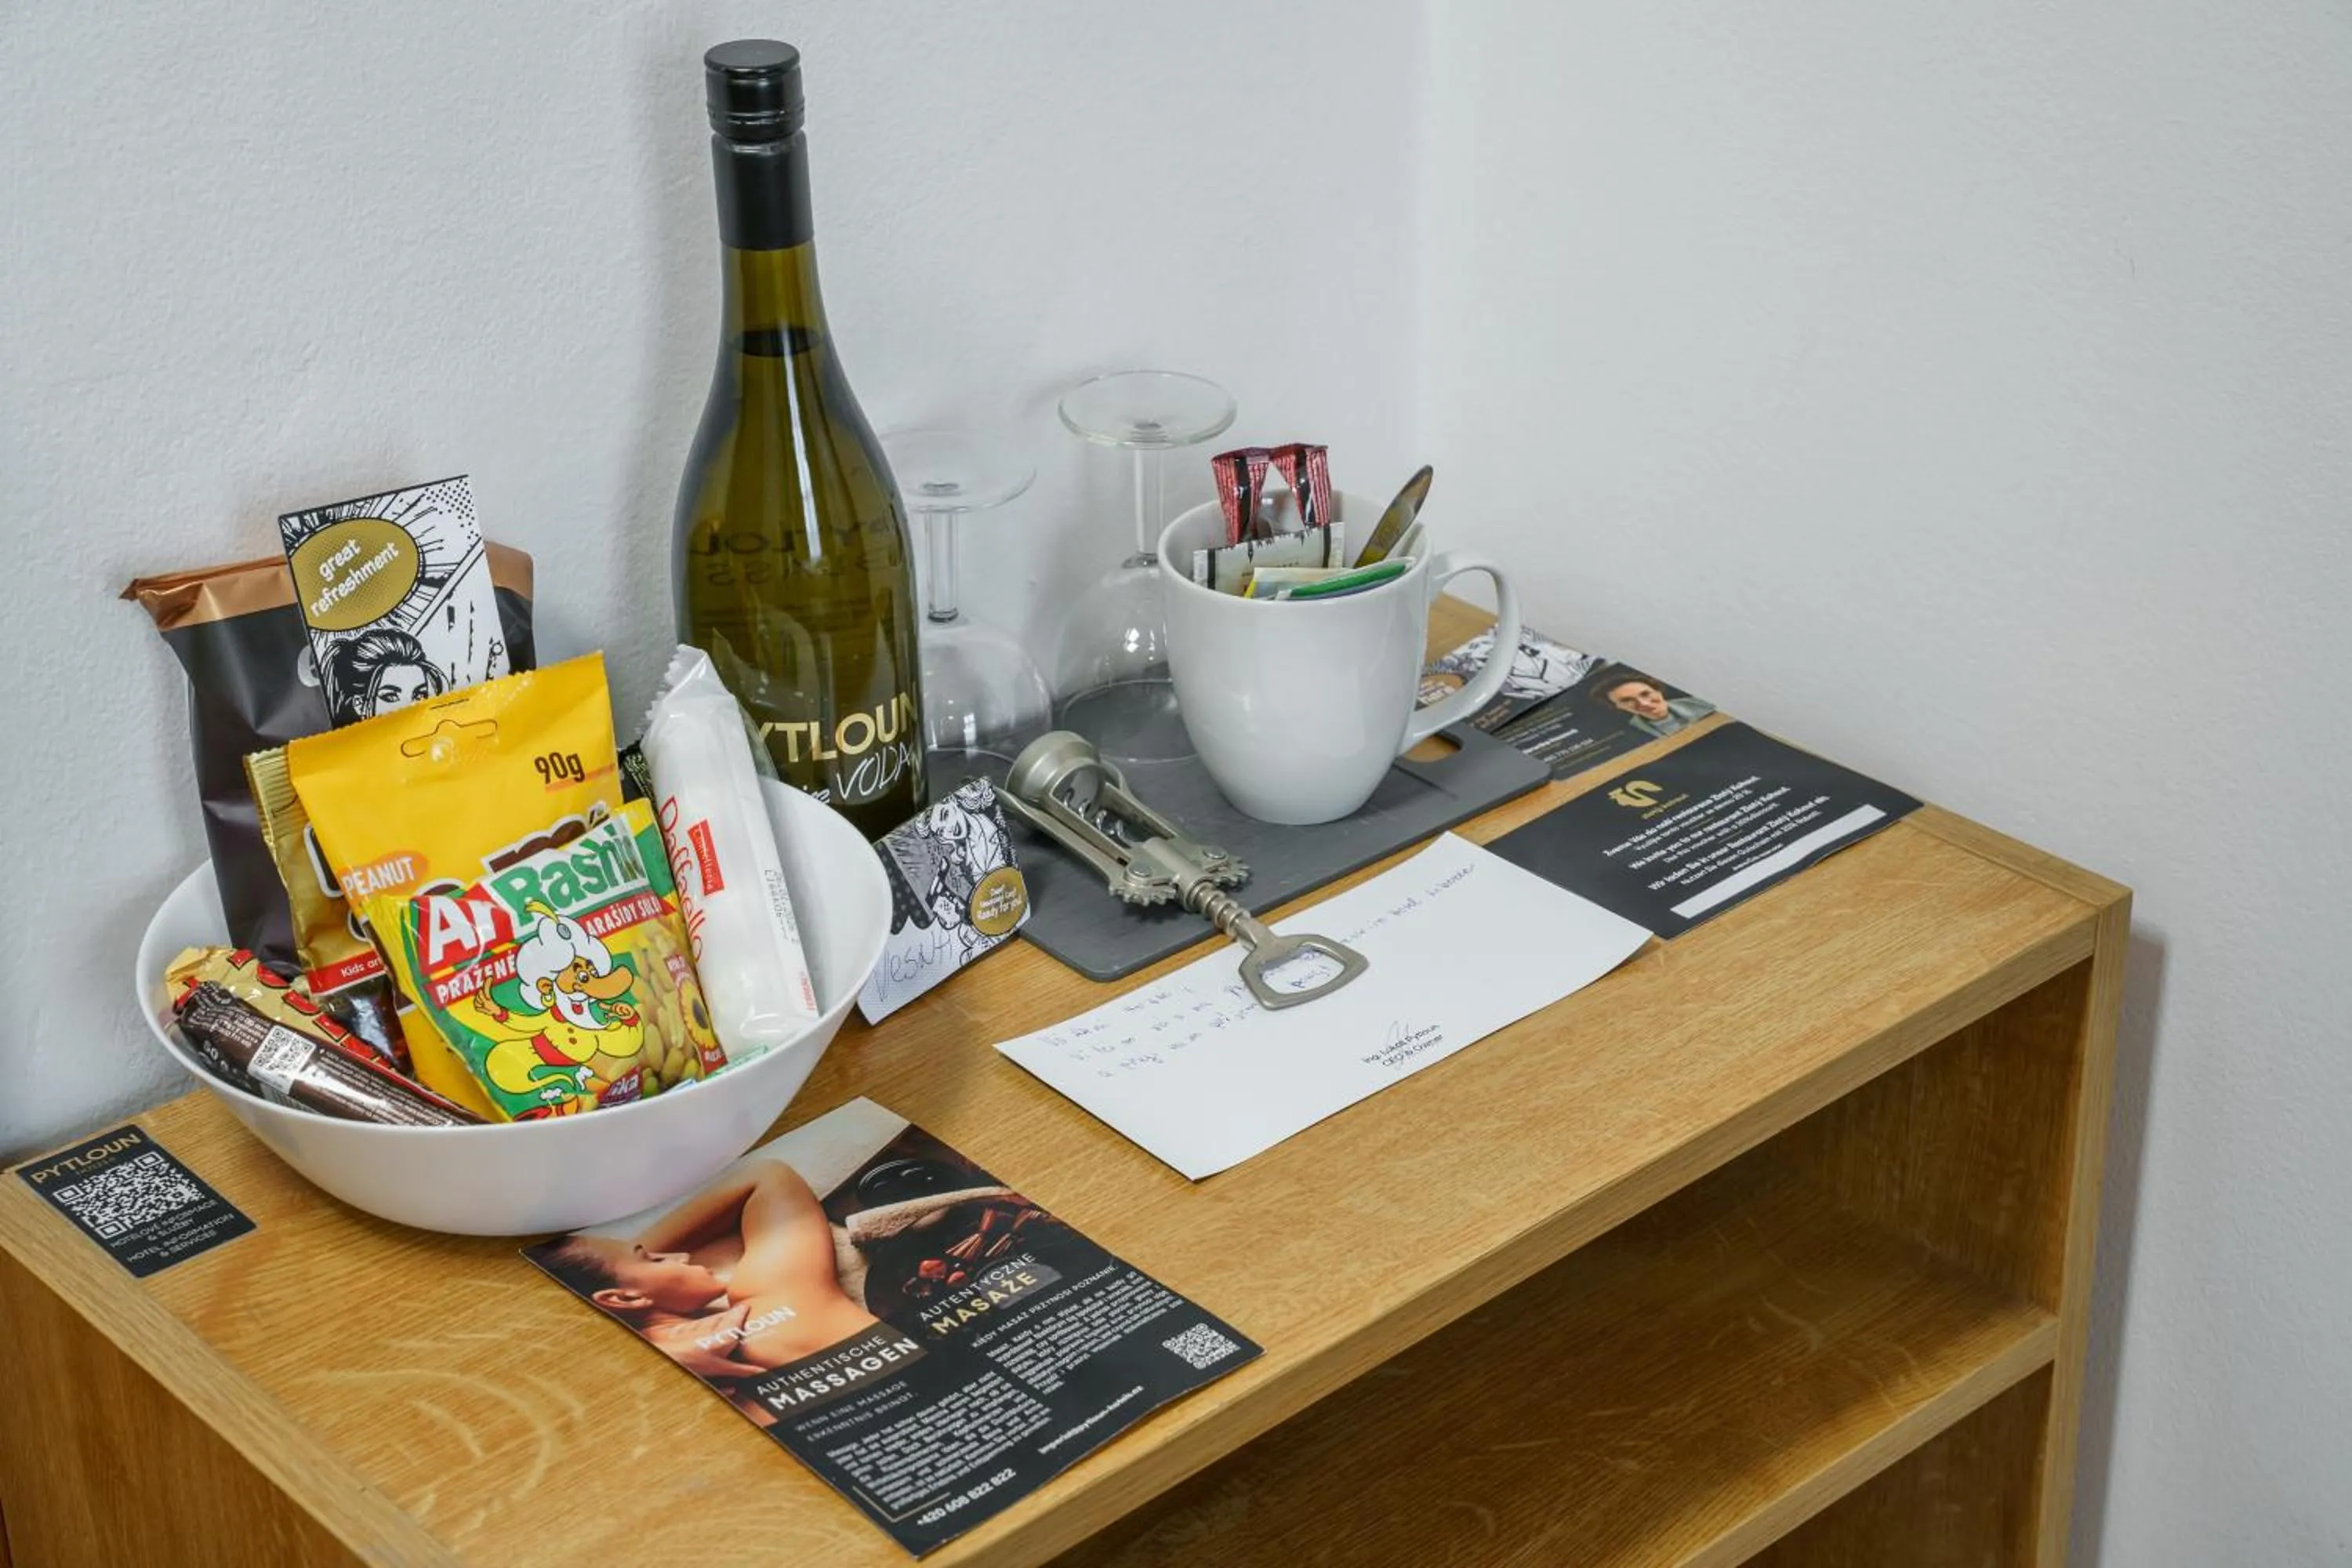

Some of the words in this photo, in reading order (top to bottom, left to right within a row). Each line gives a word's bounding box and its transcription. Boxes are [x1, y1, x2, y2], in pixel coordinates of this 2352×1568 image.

[310, 543, 399, 618] refreshment
[319, 539, 361, 580] great
[534, 750, 585, 784] 90g
[340, 856, 416, 901] PEANUT
[429, 895, 496, 965] Ar
[436, 949, 517, 1004] PRAŽENÉ
[587, 900, 637, 937] ARAŠÍDY
[340, 963, 365, 978] Kids
[31, 1134, 140, 1182] PYTLOUN
[920, 1252, 1036, 1322] AUTENTYCZNE
[931, 1272, 1038, 1334] MASAŻE
[695, 1305, 797, 1350] PYTLOUN
[756, 1336, 887, 1396] AUTHENTISCHE
[768, 1338, 920, 1411] MASSAGEN
[916, 1505, 946, 1526] +420
[946, 1494, 970, 1515] 608
[970, 1482, 993, 1503] 822
[992, 1466, 1018, 1488] 822
